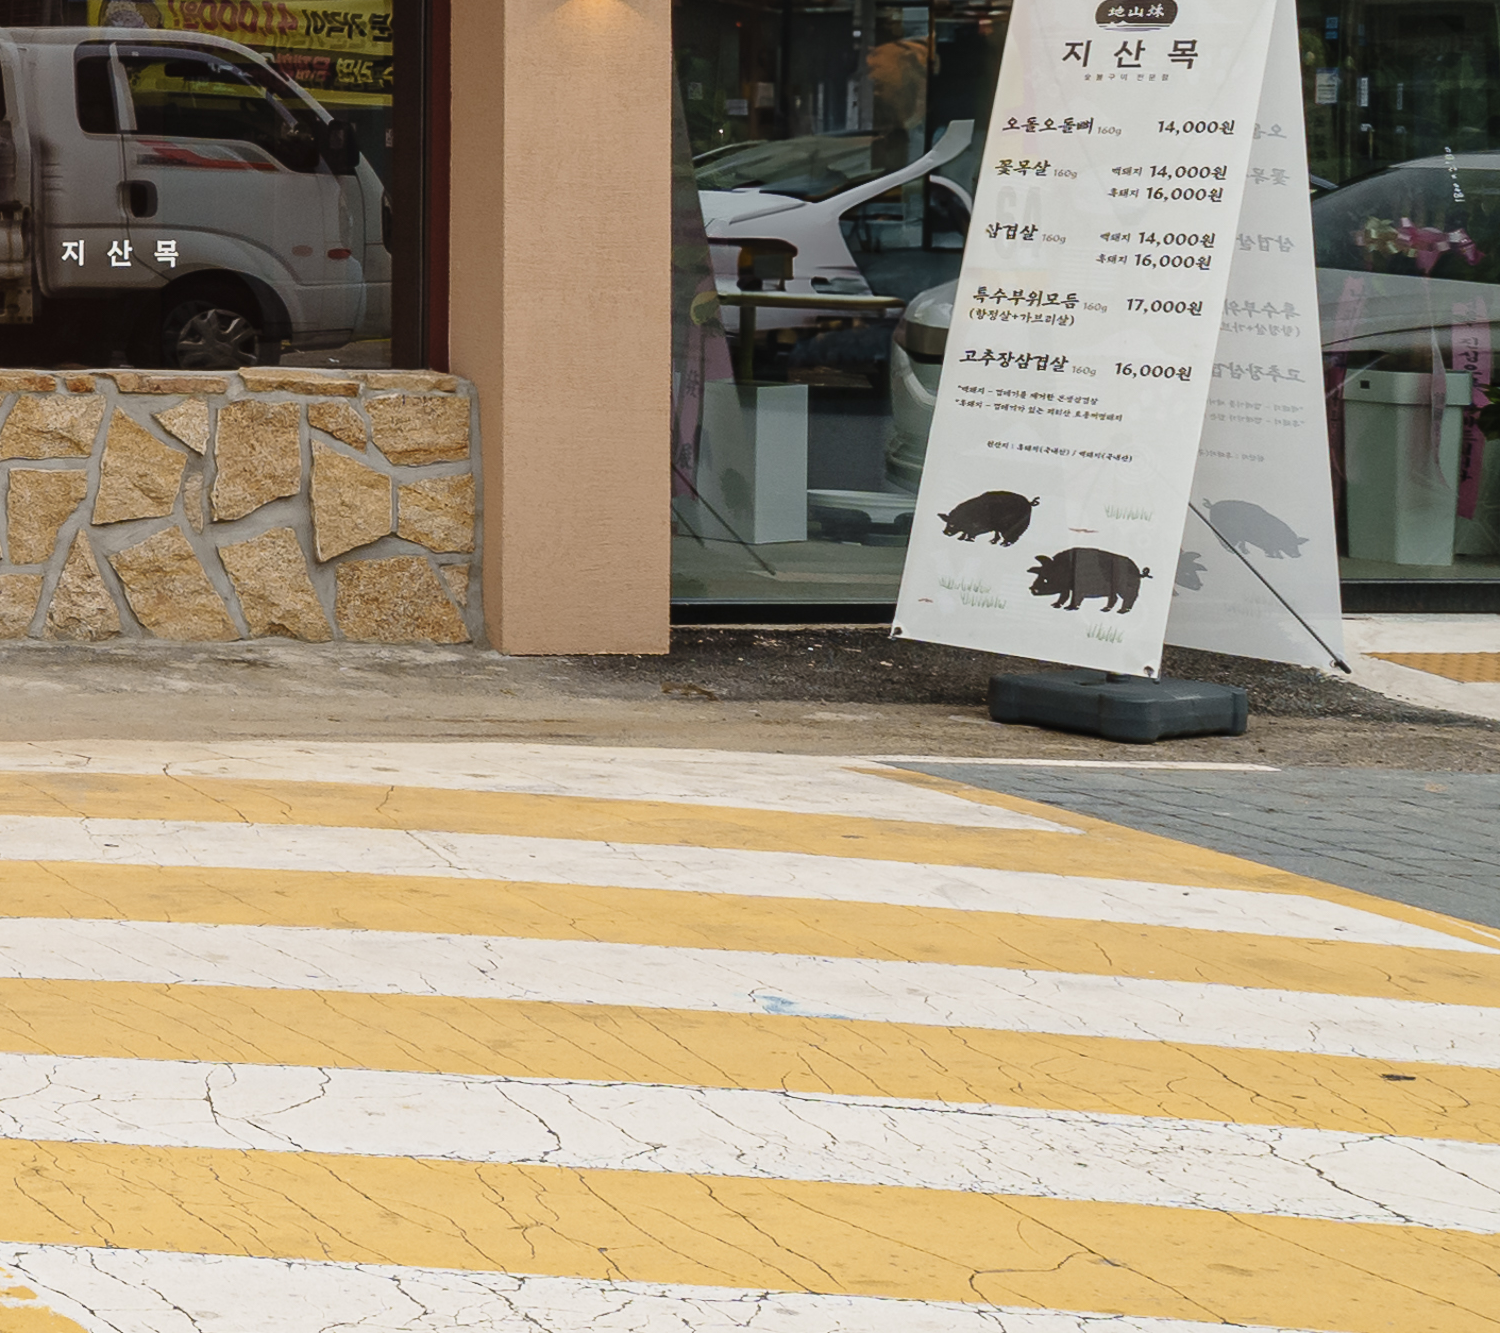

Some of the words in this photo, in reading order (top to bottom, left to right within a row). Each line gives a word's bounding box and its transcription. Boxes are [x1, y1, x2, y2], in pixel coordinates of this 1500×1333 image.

[1061, 39, 1198, 70] 지산목
[1002, 116, 1095, 135] 오돌오돌뼈
[1097, 125, 1122, 137] 160g
[1157, 118, 1236, 136] 14,000원
[994, 159, 1052, 177] 꽃목살
[1053, 169, 1078, 180] 160g
[1149, 163, 1228, 182] 14,000원
[1145, 185, 1224, 204] 16,000원
[985, 222, 1039, 241] 삼겹살
[1041, 232, 1067, 245] 160g
[1137, 230, 1216, 249] 14,000원
[1134, 252, 1212, 271] 16,000원
[972, 286, 1080, 310] 특수부위모듬
[1083, 301, 1108, 313] 160g
[1126, 297, 1204, 317] 17,000원
[968, 307, 1075, 327] (항정살+가브리살)
[958, 348, 1069, 374] 고추장삼겹살
[1072, 365, 1097, 377] 160g
[1114, 362, 1193, 383] 16,000원
